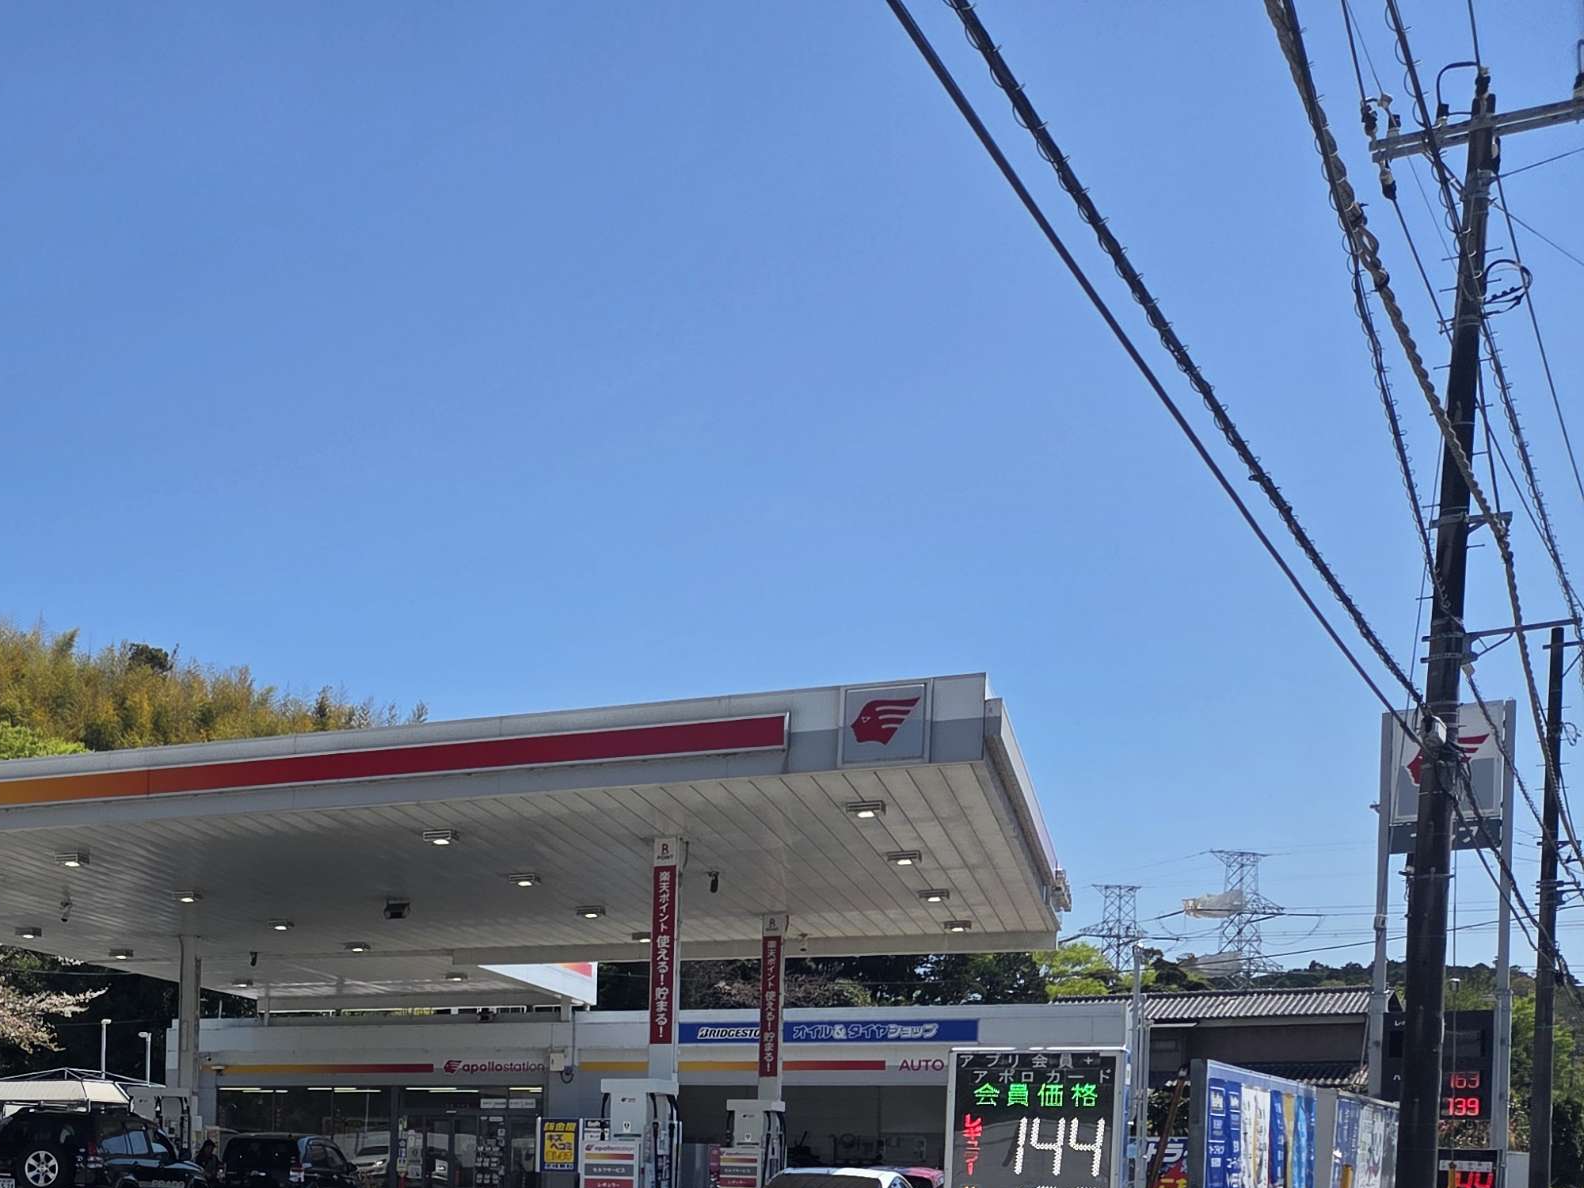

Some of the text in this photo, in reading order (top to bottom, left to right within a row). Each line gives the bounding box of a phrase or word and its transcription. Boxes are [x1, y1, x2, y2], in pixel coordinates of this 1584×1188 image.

[462, 1060, 545, 1074] apollostation
[898, 1059, 945, 1072] AUTO
[973, 1083, 1098, 1107] 会員価格
[962, 1113, 984, 1176] レギュラー
[1014, 1116, 1106, 1177] 144
